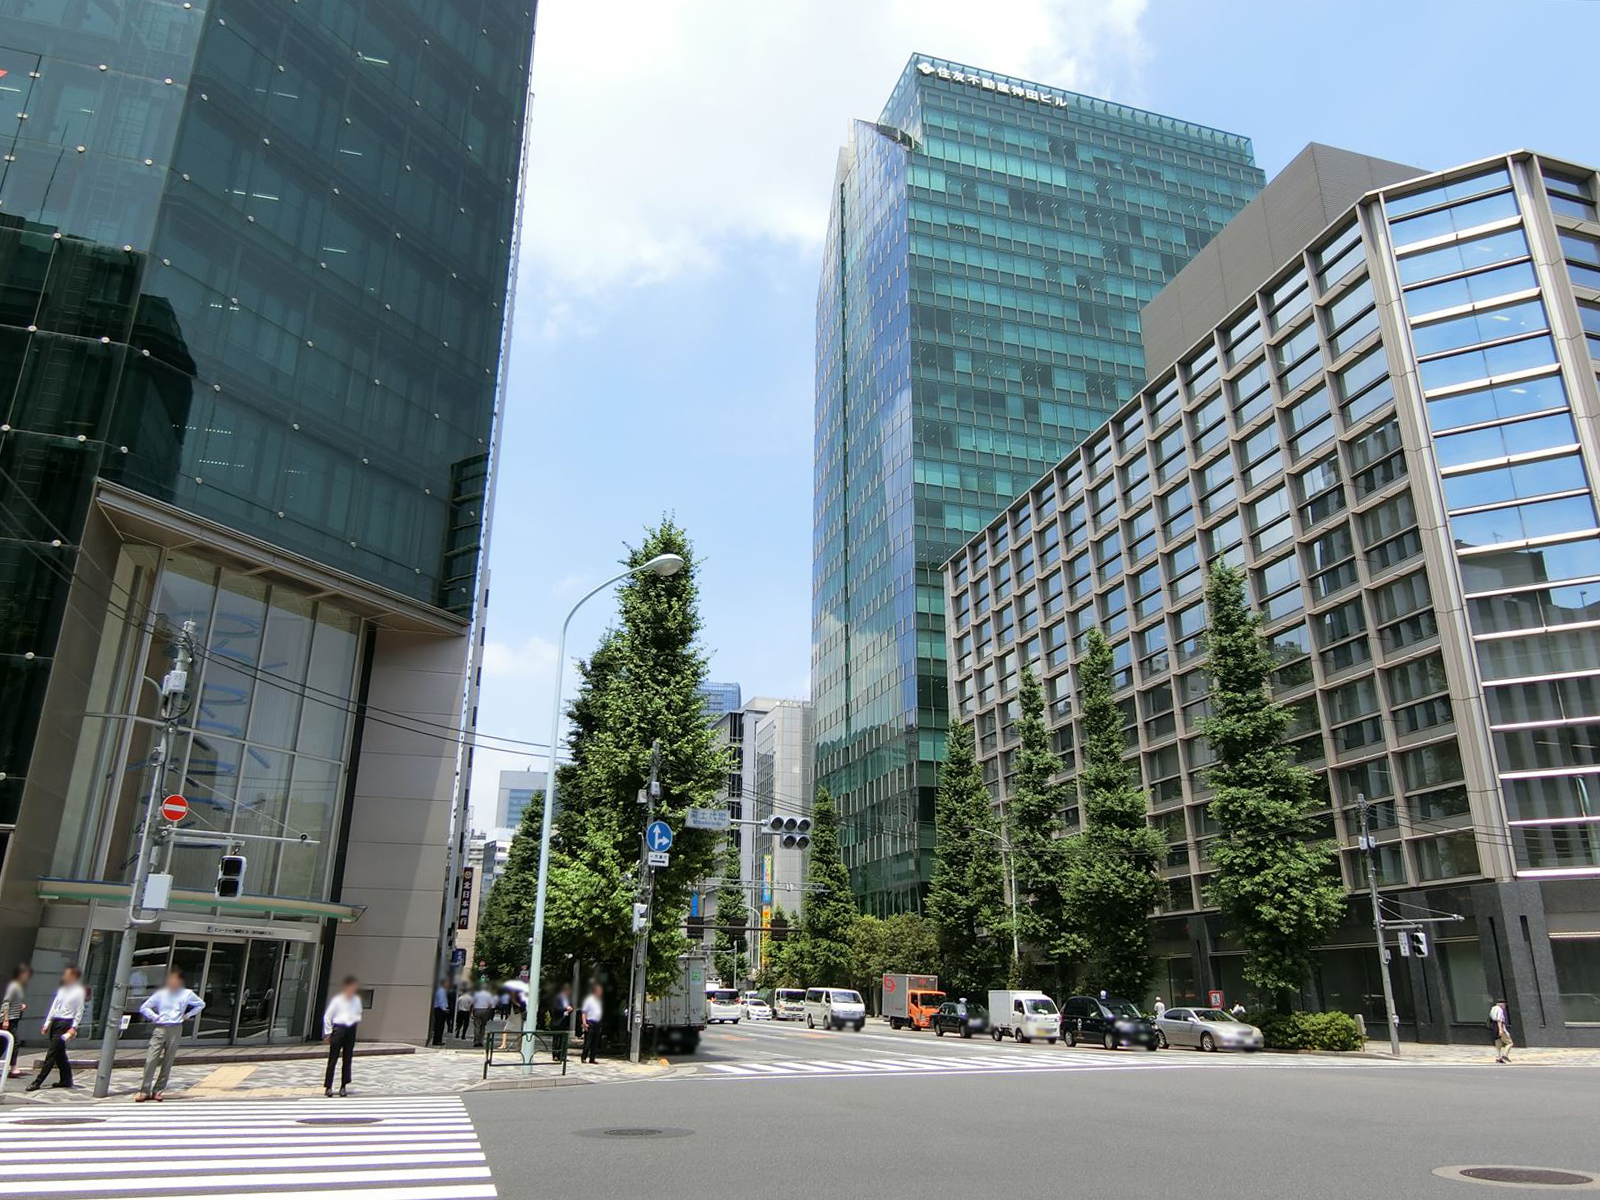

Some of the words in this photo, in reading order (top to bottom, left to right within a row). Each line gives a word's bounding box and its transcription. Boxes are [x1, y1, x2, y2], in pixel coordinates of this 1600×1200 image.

[937, 67, 1067, 107] 住友不動産神田ビル
[460, 882, 471, 925] 北日本銀行
